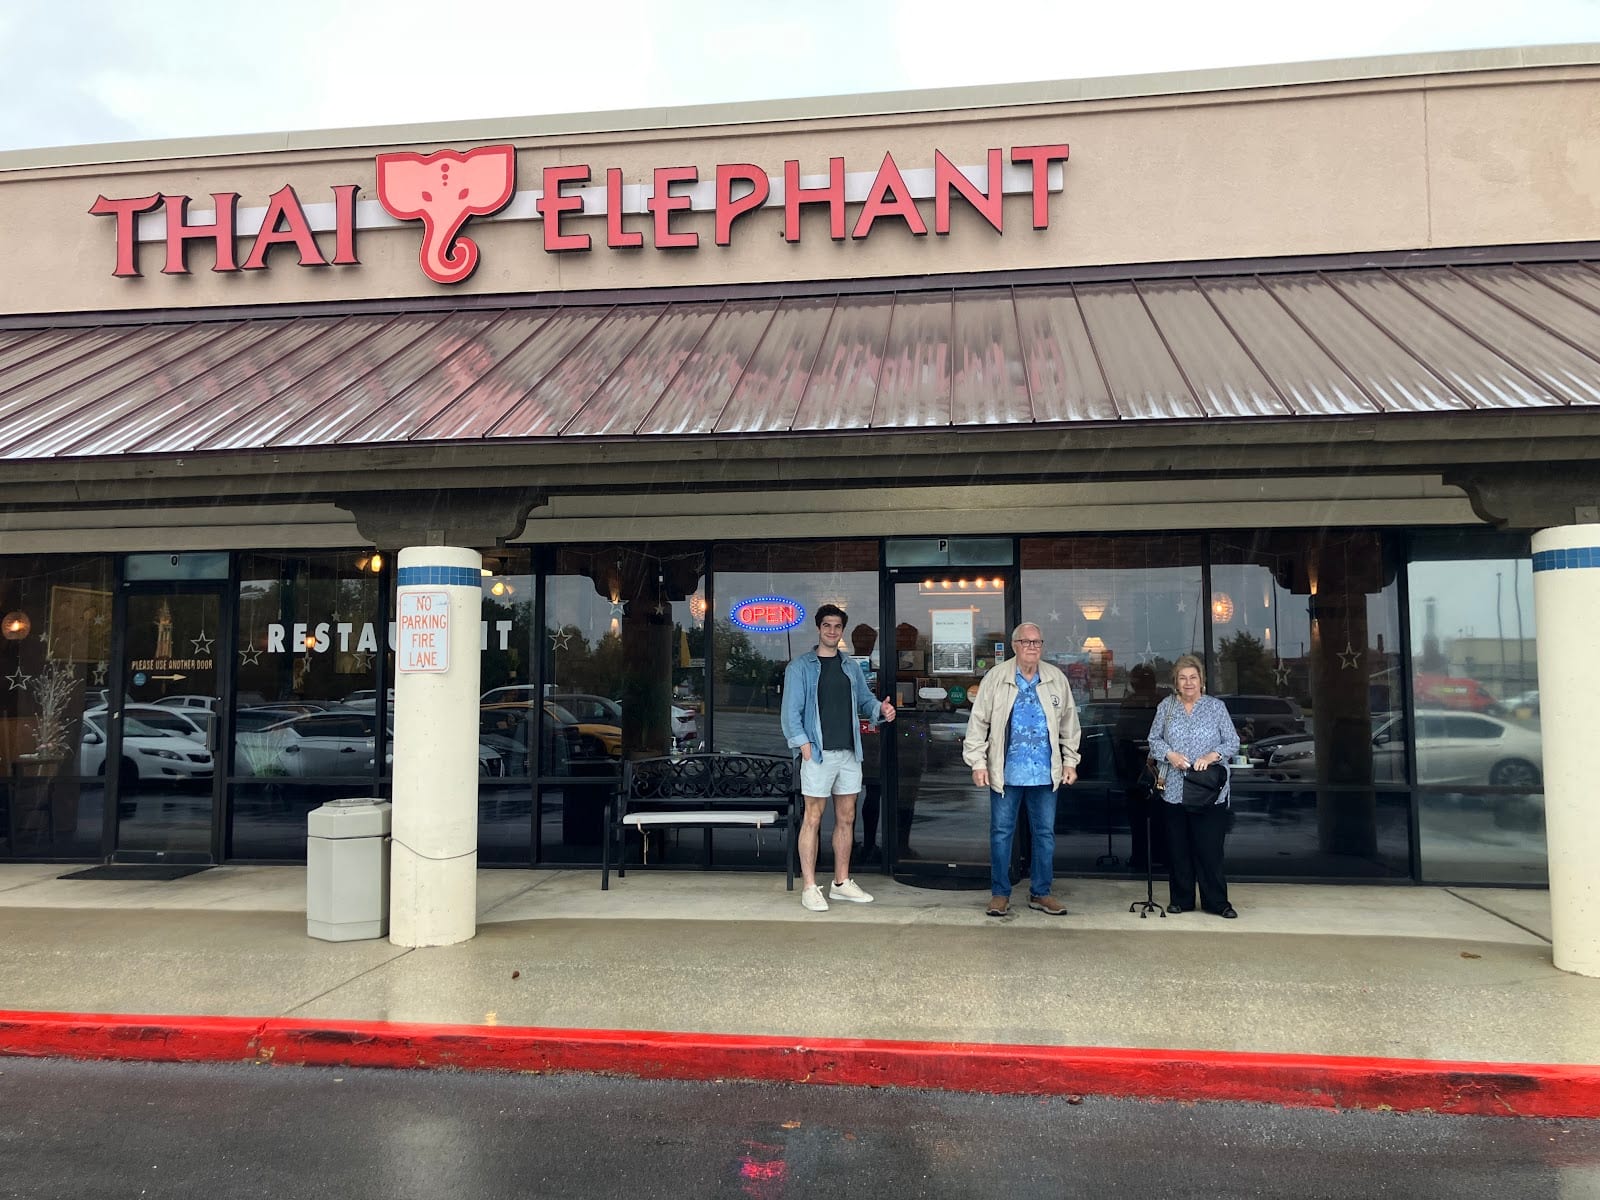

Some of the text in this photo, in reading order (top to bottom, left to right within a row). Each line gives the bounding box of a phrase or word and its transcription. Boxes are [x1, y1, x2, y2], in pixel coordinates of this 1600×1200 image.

[87, 143, 1070, 278] THAI ELEPHANT
[939, 540, 947, 552] P
[416, 596, 432, 611] NO
[401, 614, 447, 630] PARKING
[740, 604, 795, 624] OPEN
[267, 620, 513, 654] RESTAT
[411, 633, 436, 648] FIRE
[131, 659, 213, 670] PLEASE USE ANOTHER DOOR
[408, 651, 438, 667] LANE
